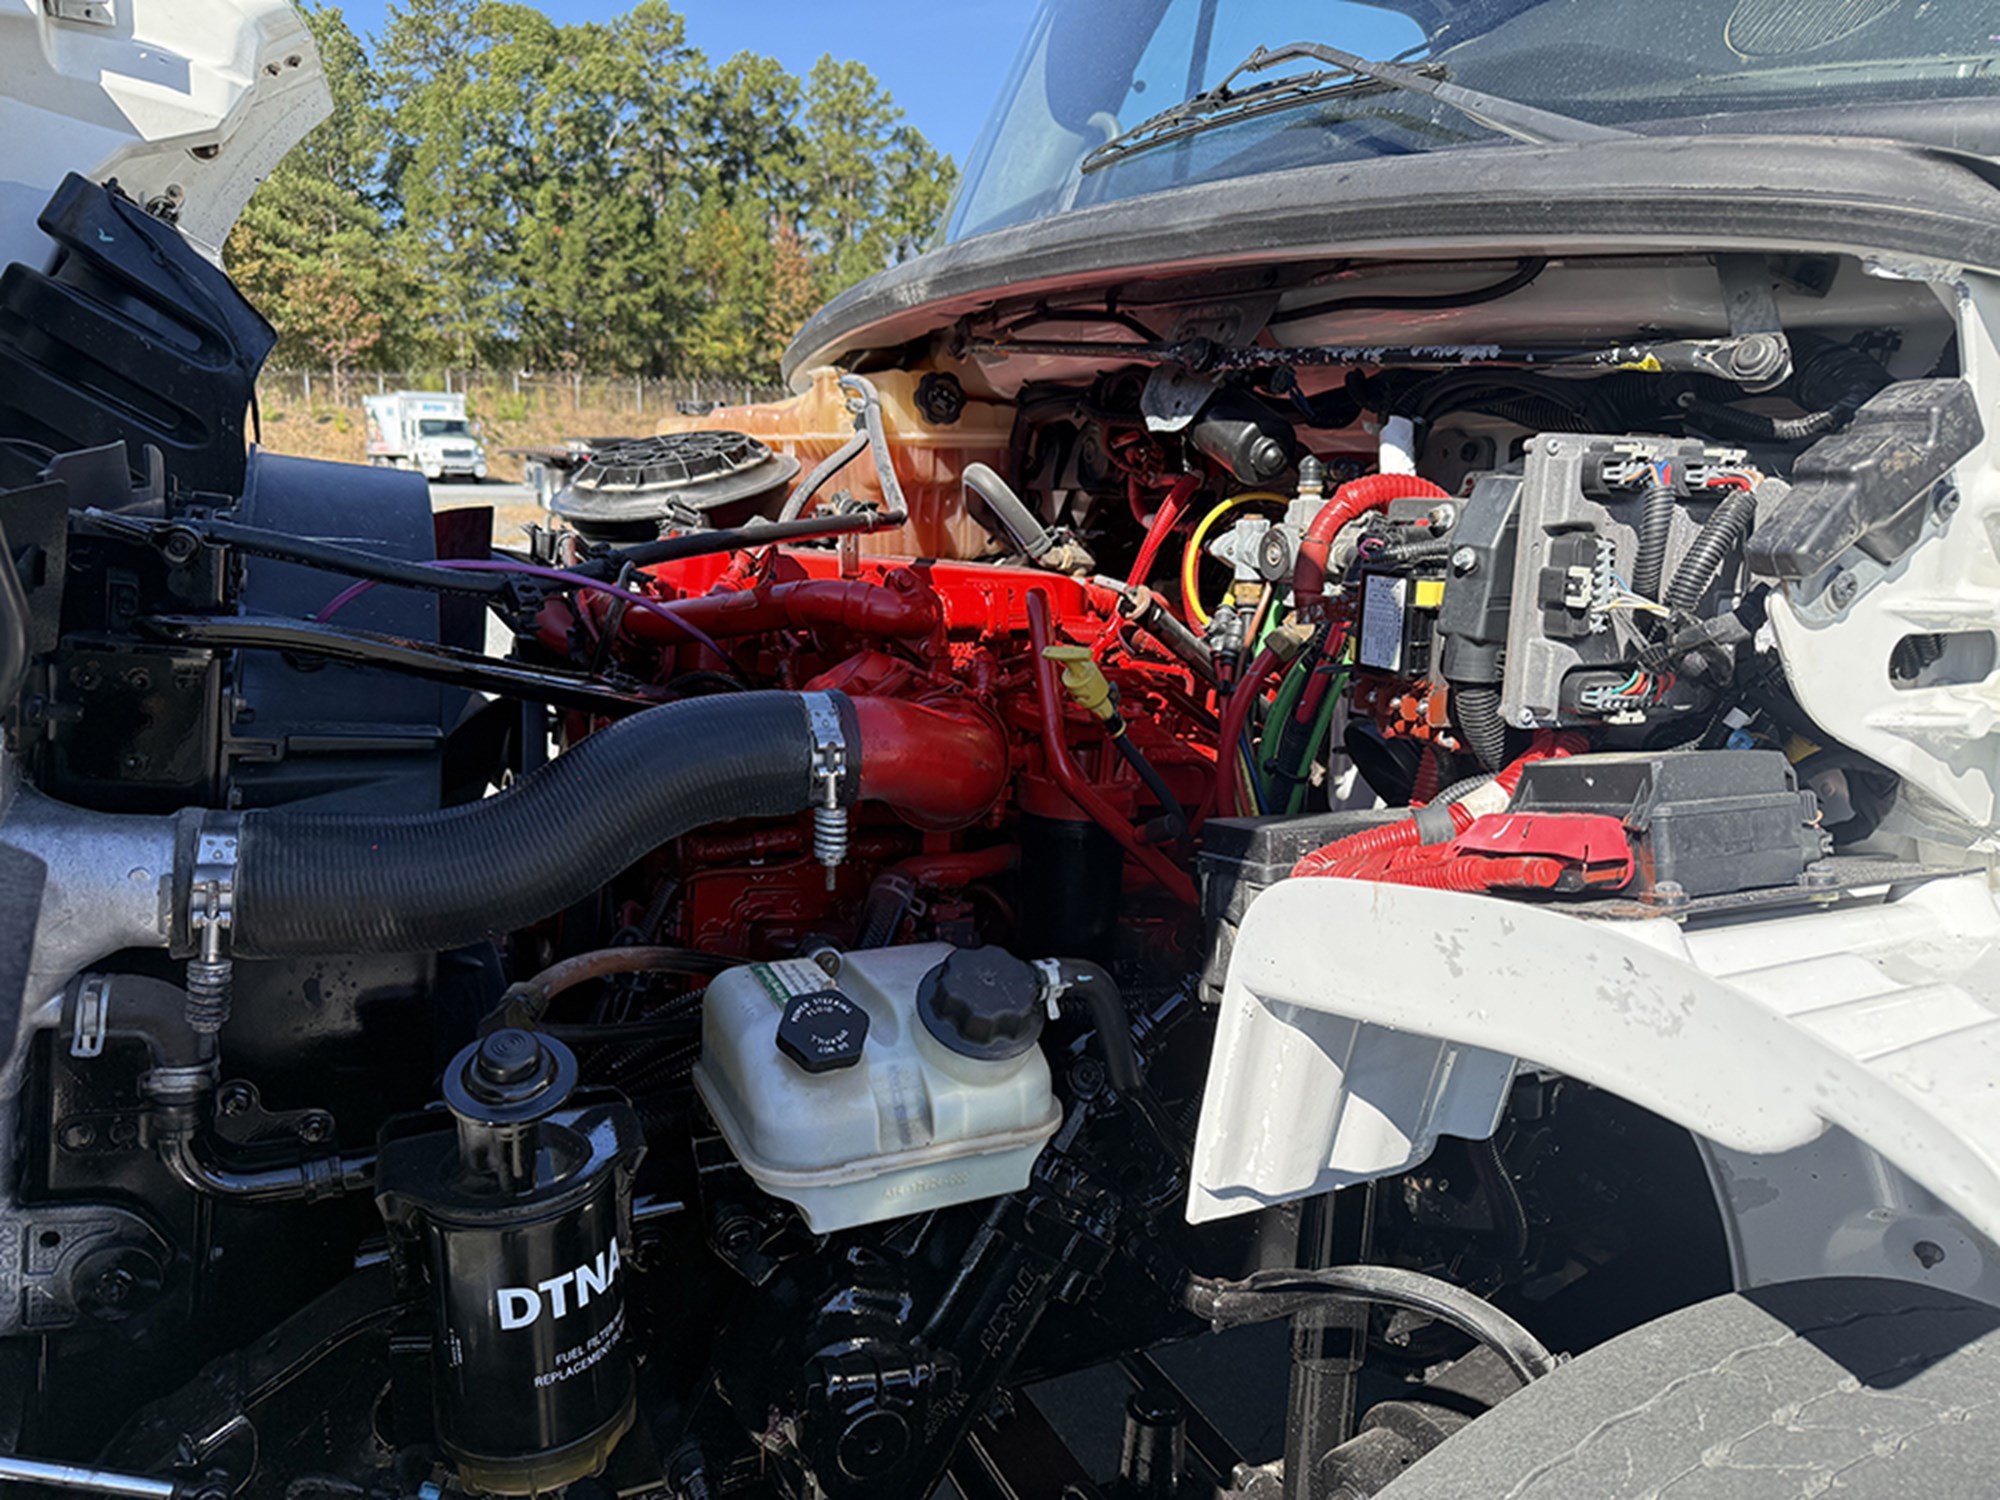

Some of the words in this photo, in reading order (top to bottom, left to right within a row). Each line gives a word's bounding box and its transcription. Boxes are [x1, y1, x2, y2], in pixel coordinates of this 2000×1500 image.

[497, 1236, 621, 1330] DTNA
[533, 1339, 612, 1388] REPLACEMENT
[555, 1345, 583, 1367] FUEL
